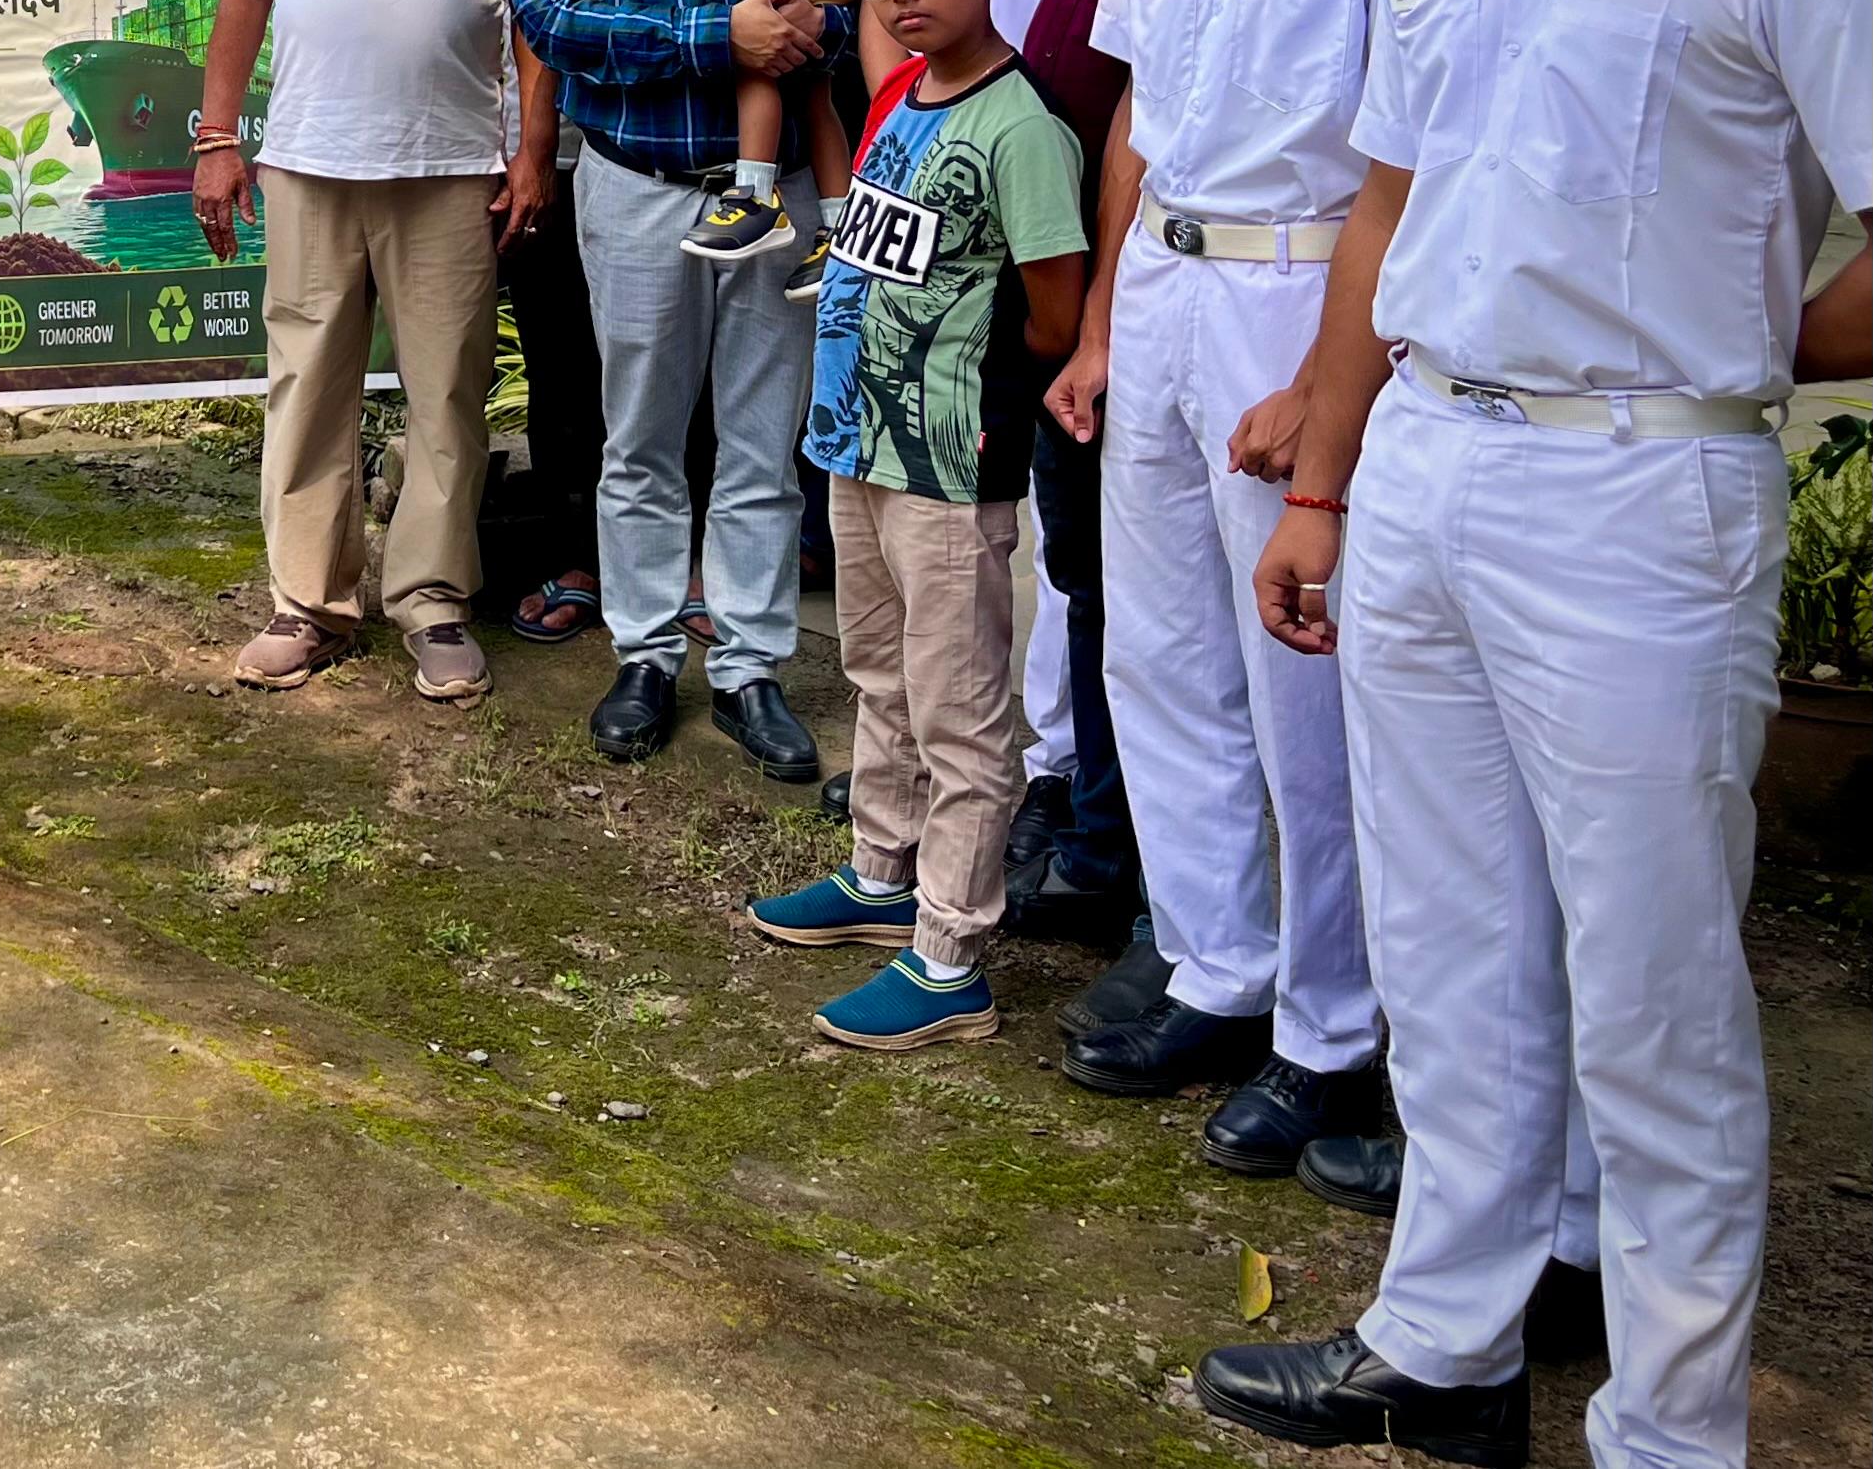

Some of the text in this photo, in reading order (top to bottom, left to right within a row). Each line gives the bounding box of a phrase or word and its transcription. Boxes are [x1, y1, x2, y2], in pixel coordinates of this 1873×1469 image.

[831, 187, 918, 276] ARVEL
[38, 299, 97, 320] GREENER
[203, 291, 250, 310] BETTER
[39, 325, 114, 346] TOMORROW
[203, 318, 249, 338] WORLD
